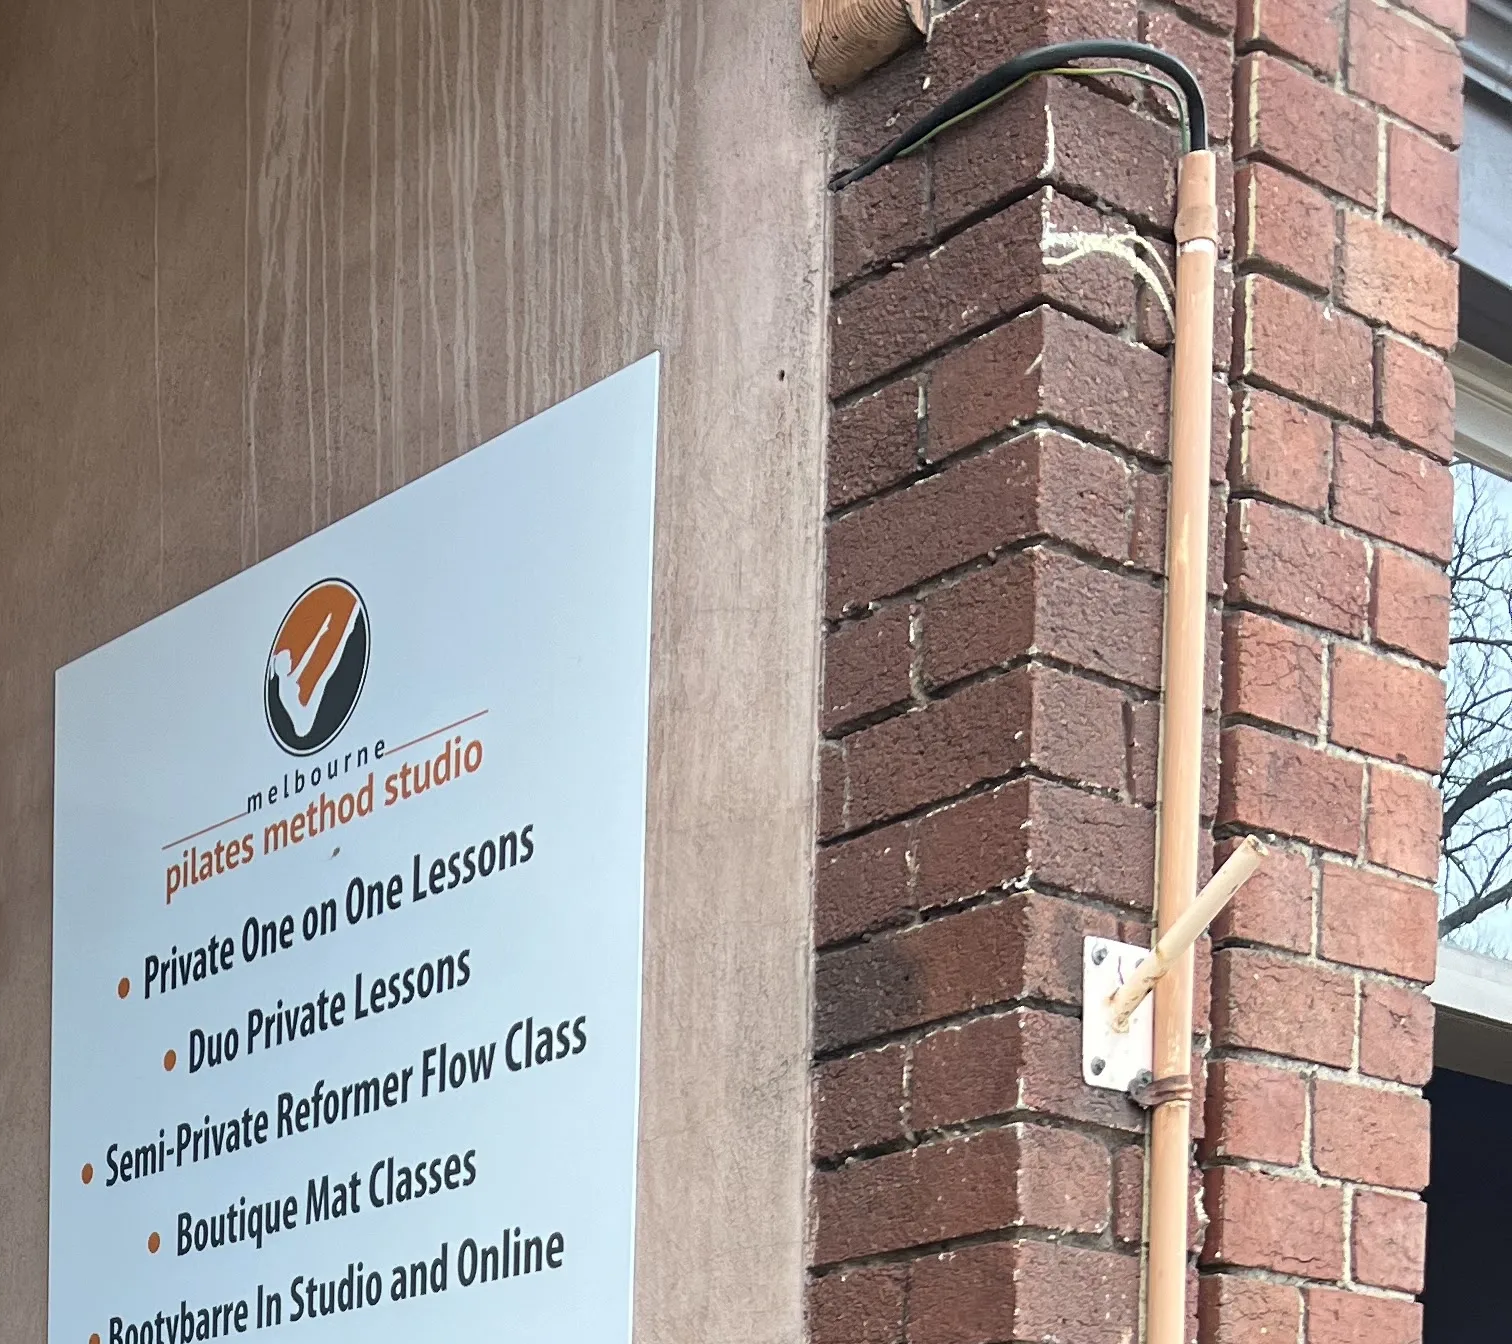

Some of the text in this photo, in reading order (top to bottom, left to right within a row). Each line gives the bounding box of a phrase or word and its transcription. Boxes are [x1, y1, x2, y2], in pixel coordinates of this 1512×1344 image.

[165, 734, 483, 905] pilates method studio
[246, 738, 386, 815] melbourne
[144, 823, 535, 999] Private One on One Lessons
[189, 947, 471, 1073] Duo Private Lessons
[105, 1014, 588, 1187] Semi-Private Reformer Flow Class
[176, 1148, 477, 1257] Boutique Mat Classes
[256, 1284, 281, 1330] In
[289, 1261, 382, 1322] Studio
[390, 1241, 448, 1301] and
[458, 1226, 565, 1289] Online
